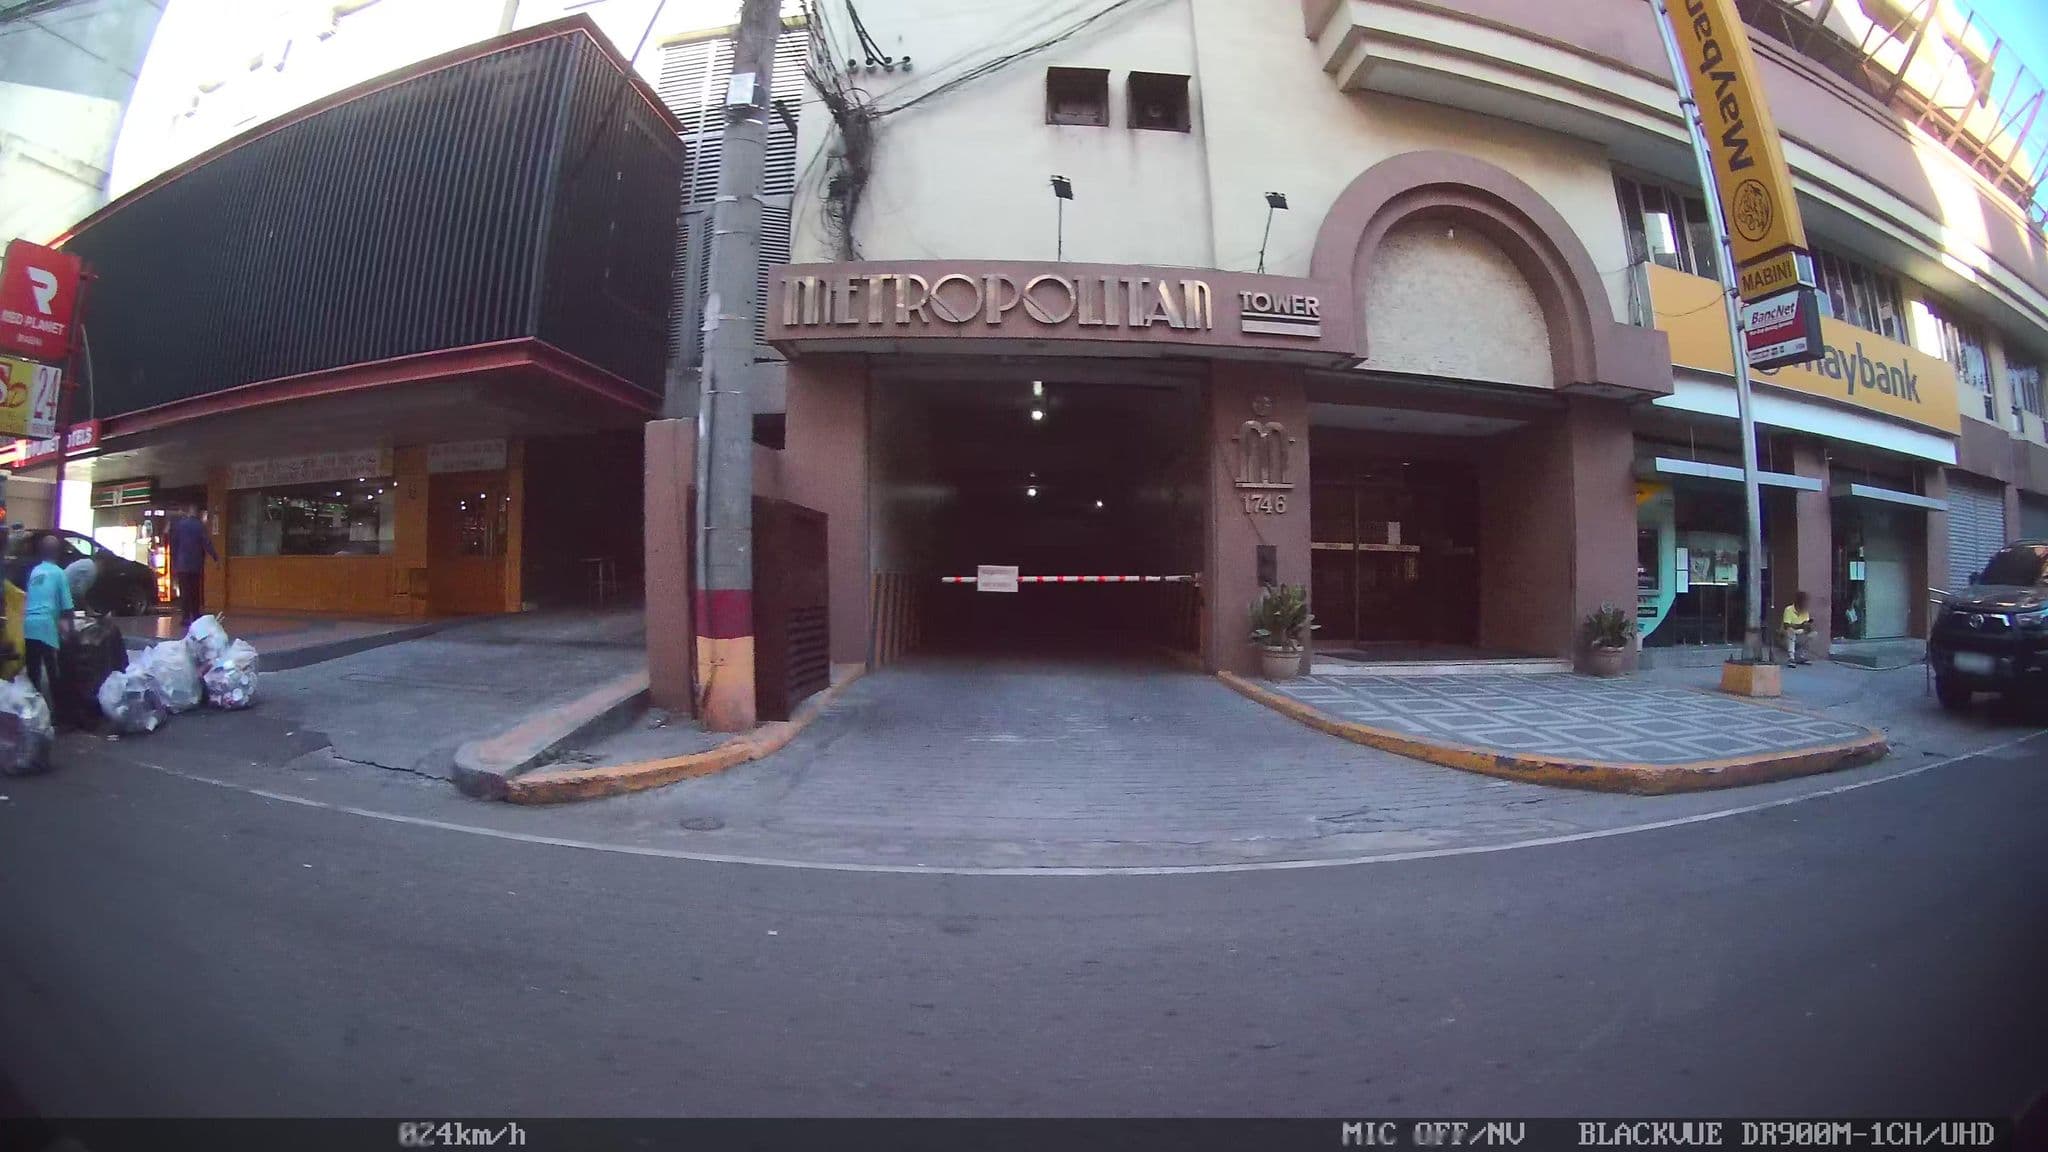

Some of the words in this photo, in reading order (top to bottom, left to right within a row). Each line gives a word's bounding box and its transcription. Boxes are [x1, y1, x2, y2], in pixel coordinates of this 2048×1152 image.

[1742, 261, 1792, 291] MABINI
[781, 273, 1212, 330] METROPOLITAN
[1239, 290, 1320, 316] TOWER
[1752, 303, 1795, 325] BancNet
[1241, 494, 1288, 514] 1746
